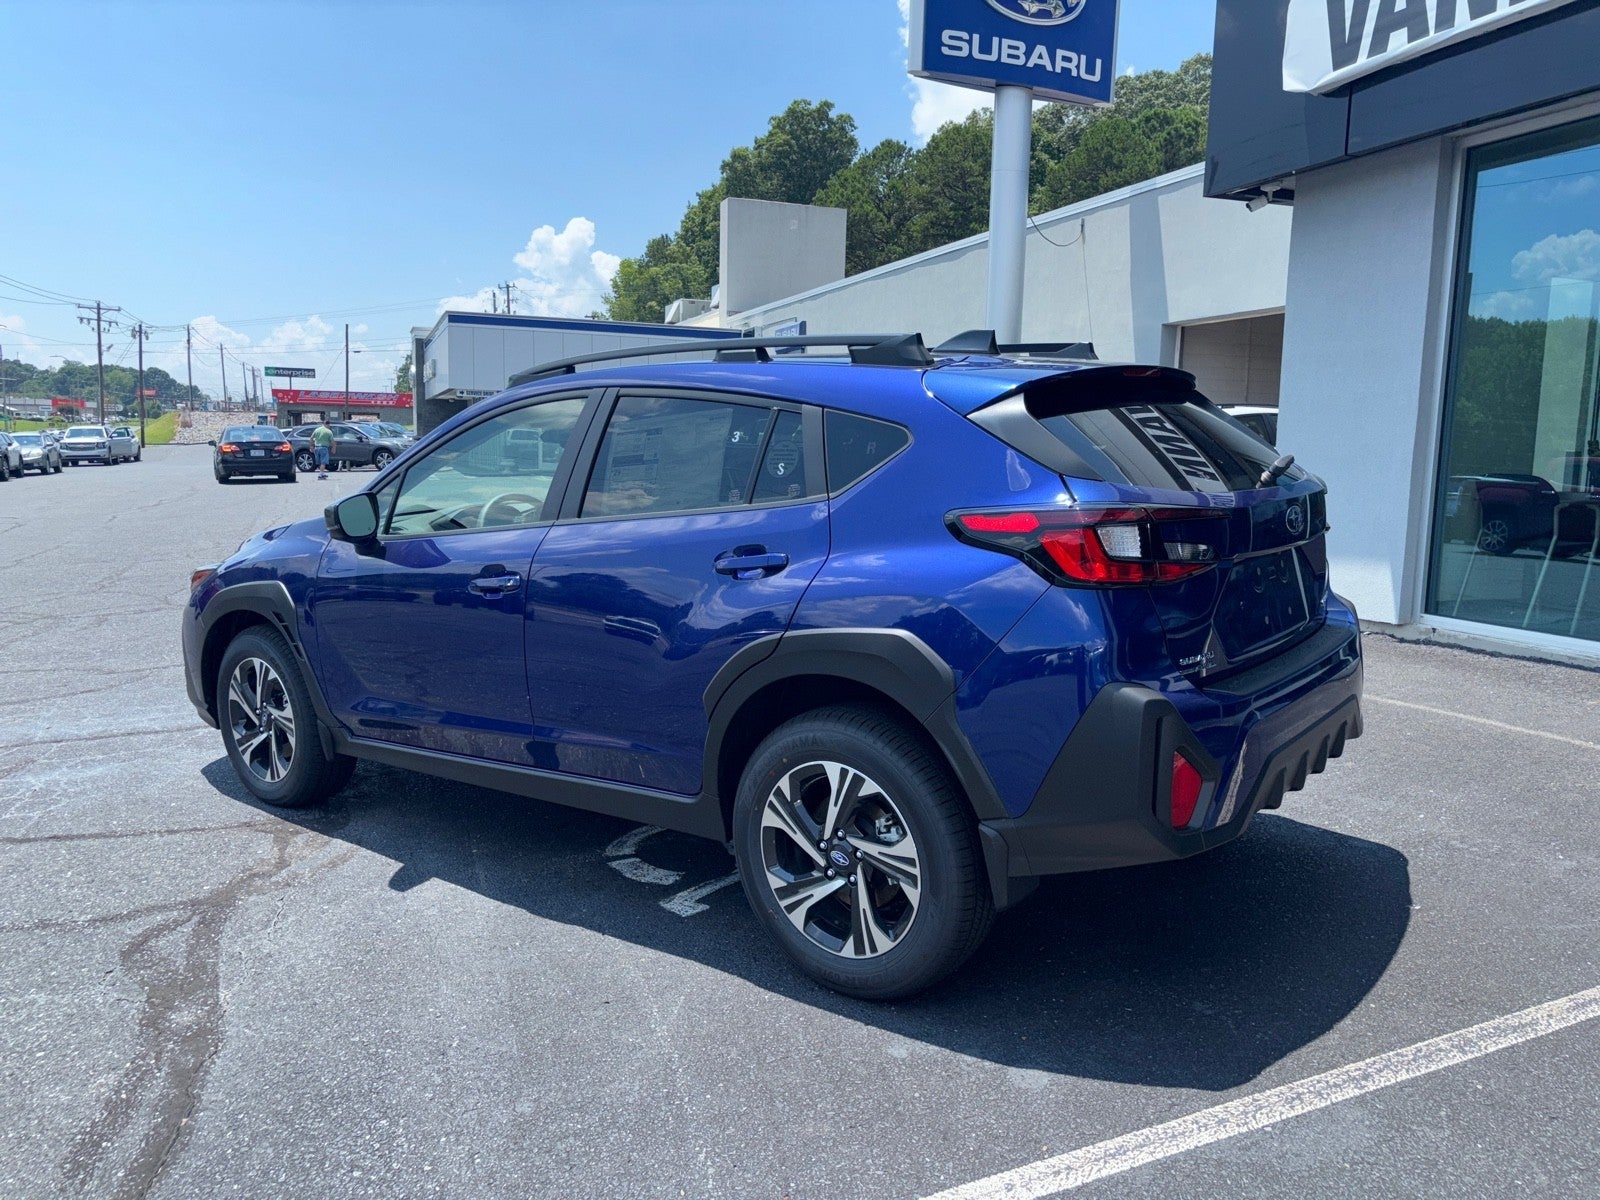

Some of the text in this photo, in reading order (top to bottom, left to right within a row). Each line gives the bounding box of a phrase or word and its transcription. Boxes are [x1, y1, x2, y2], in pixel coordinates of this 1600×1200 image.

[940, 29, 1102, 83] SUBARU
[1325, 0, 1551, 72] VA
[267, 368, 315, 377] enterprise
